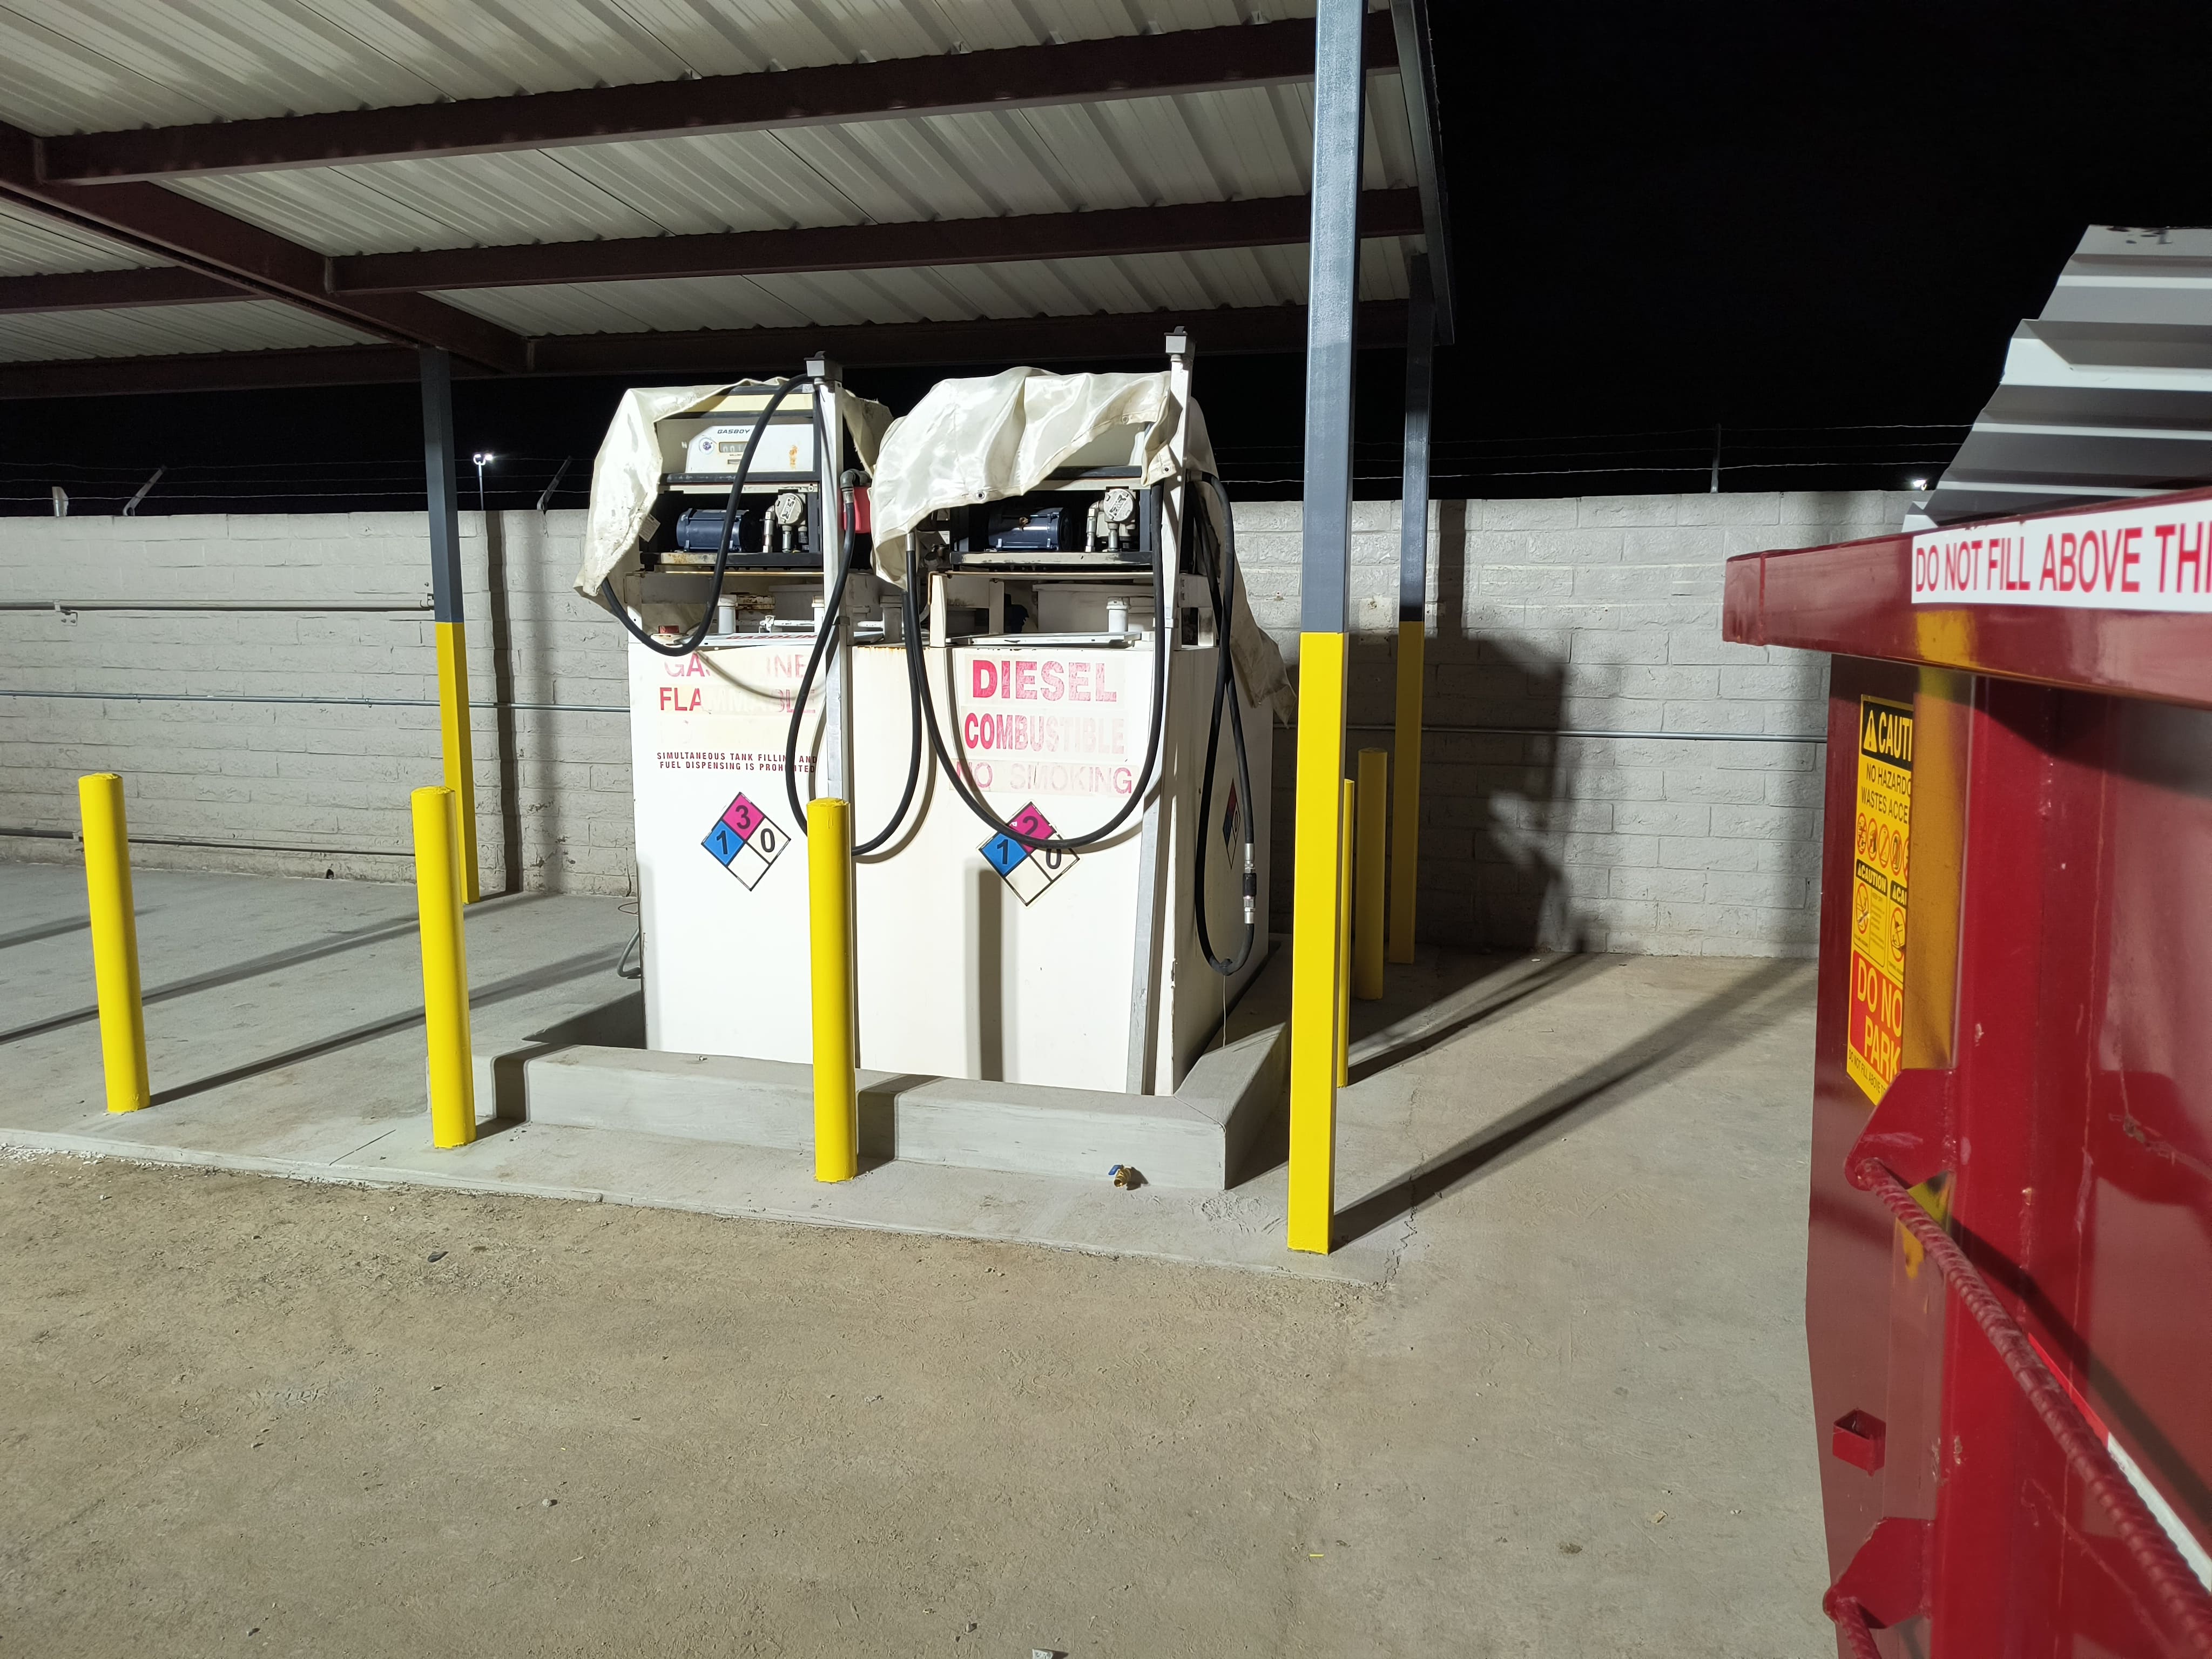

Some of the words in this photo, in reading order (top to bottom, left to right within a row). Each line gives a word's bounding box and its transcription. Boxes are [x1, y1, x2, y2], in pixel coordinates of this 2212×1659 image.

[1916, 544, 1939, 592] DO
[1945, 540, 1982, 591] NOT
[1987, 536, 2031, 591] FILL
[2039, 527, 2143, 593] ABOVE
[973, 659, 1117, 702] DIESEL
[964, 712, 1125, 754] COMBUSTIBLE
[657, 752, 725, 760] SIMULTANEOUS
[730, 753, 753, 761] TANK
[758, 754, 786, 762] FILLIN
[799, 756, 817, 764] AND
[686, 761, 740, 770] DISPENSING
[759, 763, 814, 773] PROHITED
[1010, 762, 1132, 794] SMOKING
[1867, 763, 1877, 783] NO
[1862, 786, 1887, 814] WASTES
[735, 805, 751, 830] 3
[716, 830, 729, 855] 1
[760, 828, 775, 853] 0
[996, 839, 1009, 865] 1
[1862, 865, 1886, 893] CAUTION
[1858, 957, 1878, 1013] DO
[1849, 1049, 1853, 1063] DO
[1864, 1015, 1901, 1082] PARK
